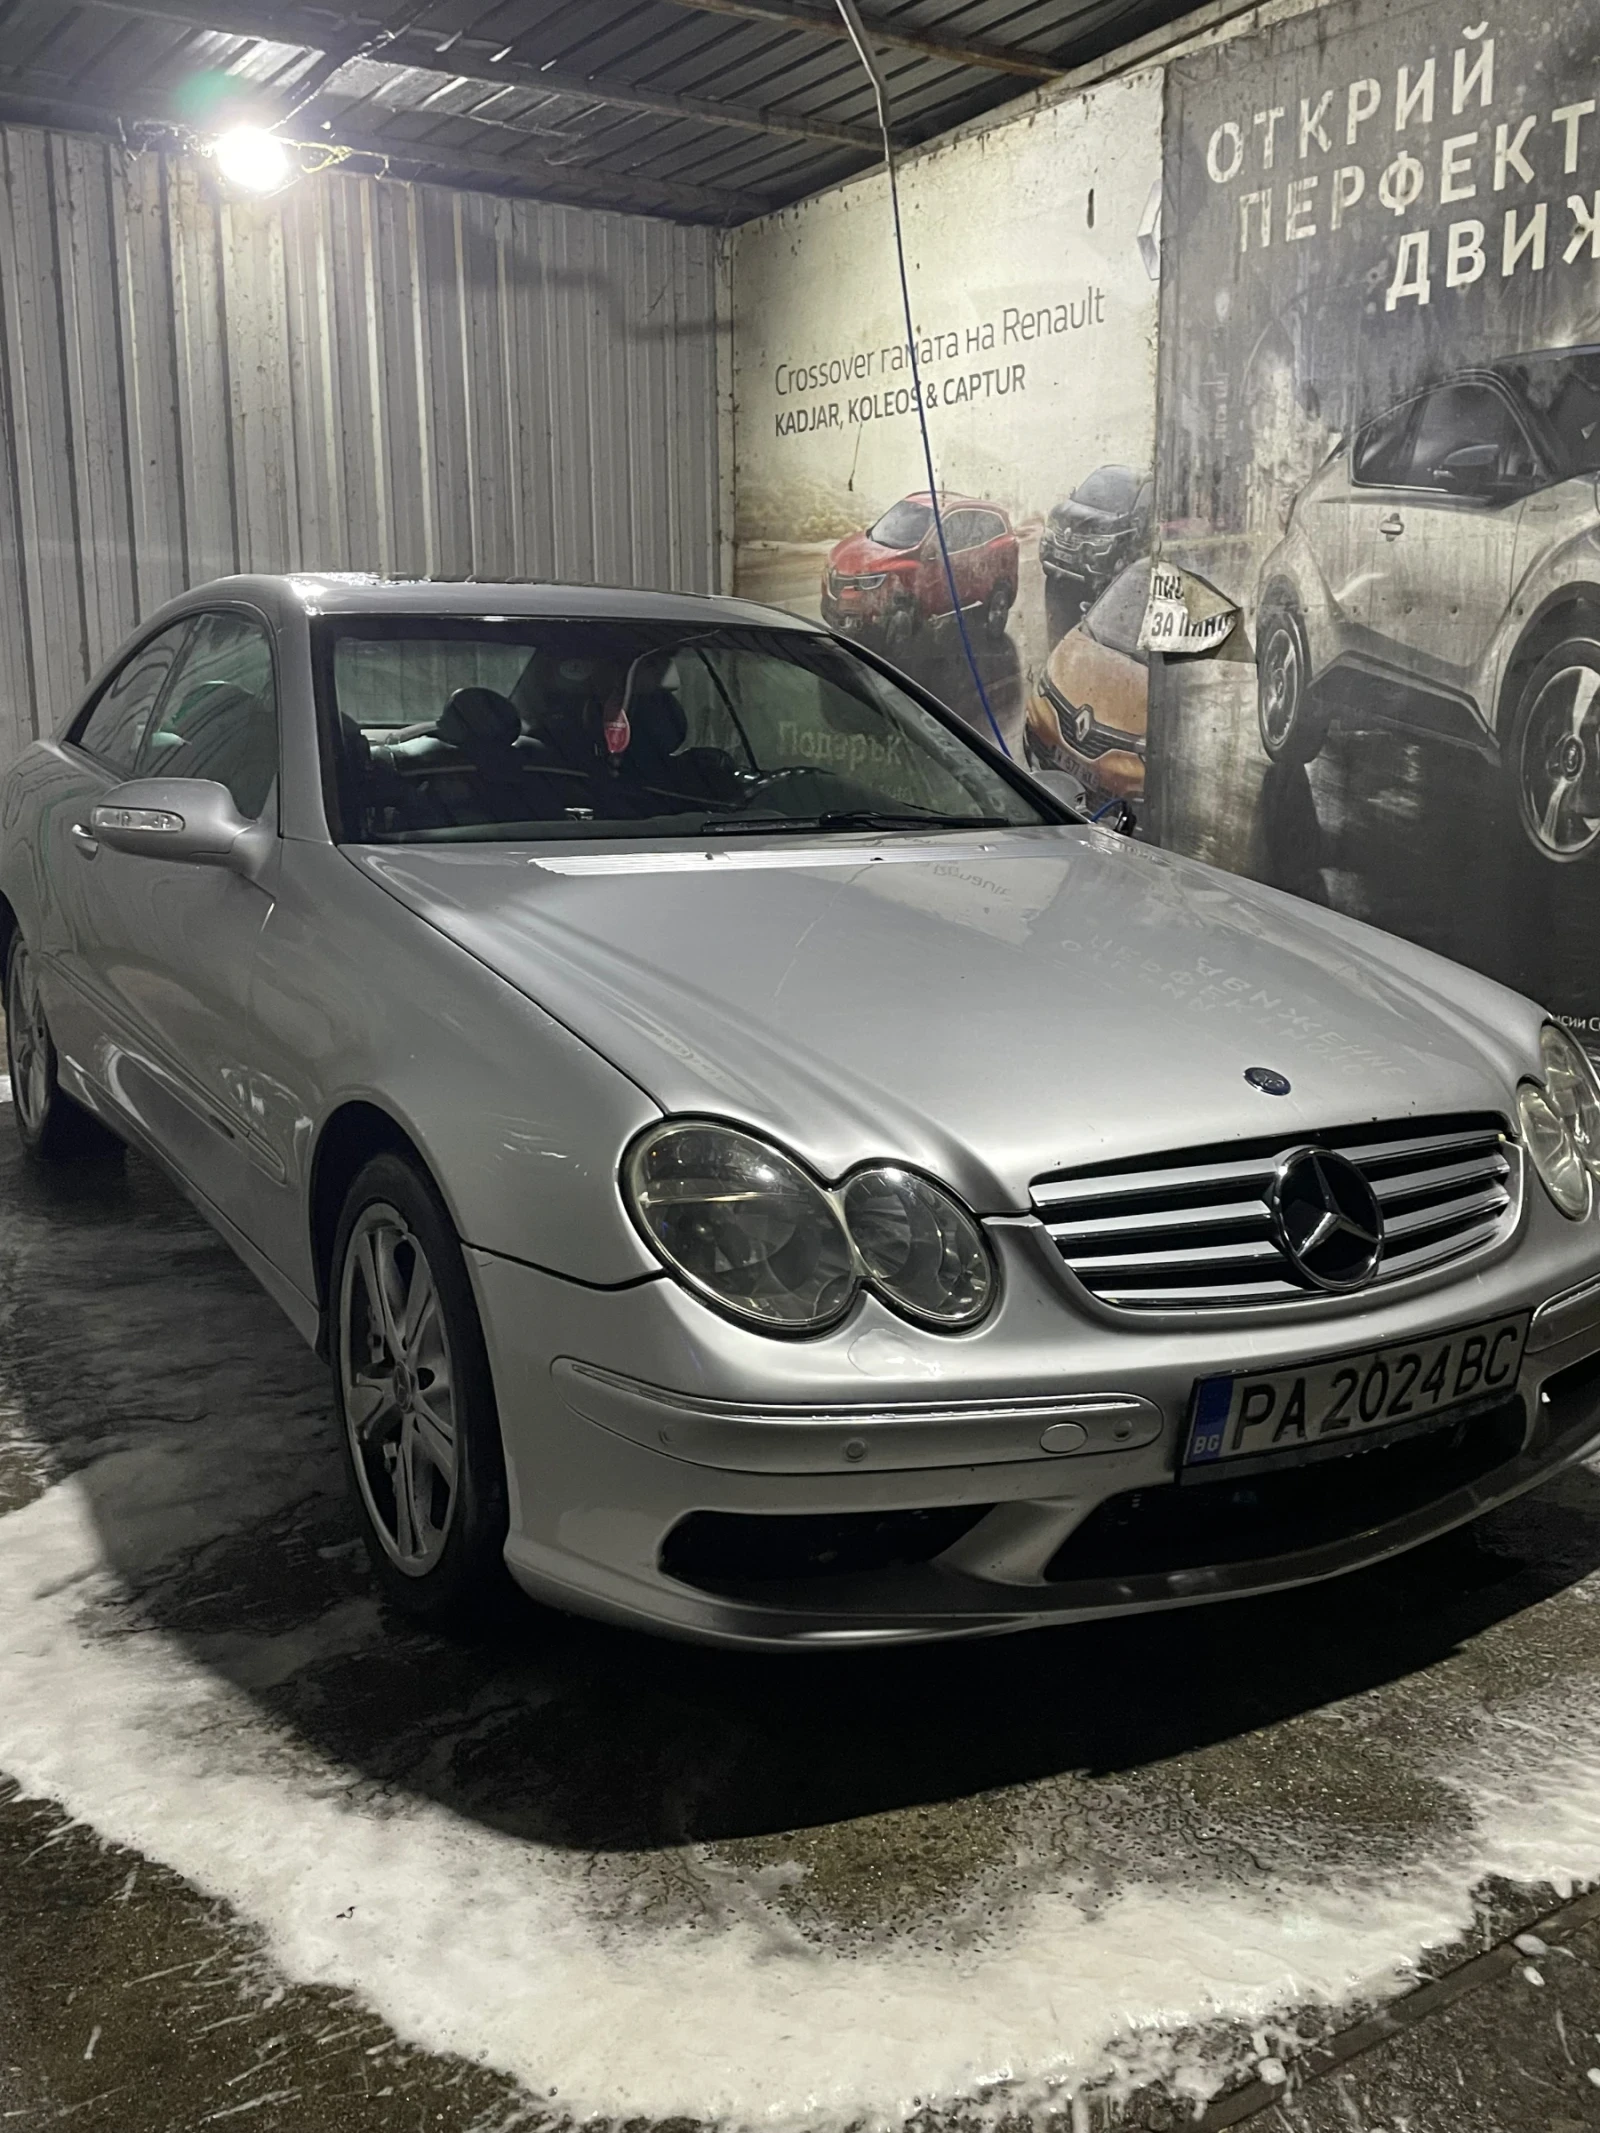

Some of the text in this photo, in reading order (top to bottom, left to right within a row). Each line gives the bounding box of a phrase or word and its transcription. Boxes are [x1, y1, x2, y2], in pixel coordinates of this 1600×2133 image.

[1207, 21, 1495, 184] ОТКРИЙ
[1238, 99, 1596, 253] ПЕРФЕКТ
[775, 349, 875, 396] Crossover
[966, 322, 995, 354] на
[1003, 286, 1105, 345] Renault
[775, 364, 1026, 437] KADJAR, KOLEOS & CAPTUR
[1151, 612, 1174, 637] ЗА
[1193, 1434, 1220, 1454] BG
[1232, 1377, 1308, 1450] PA
